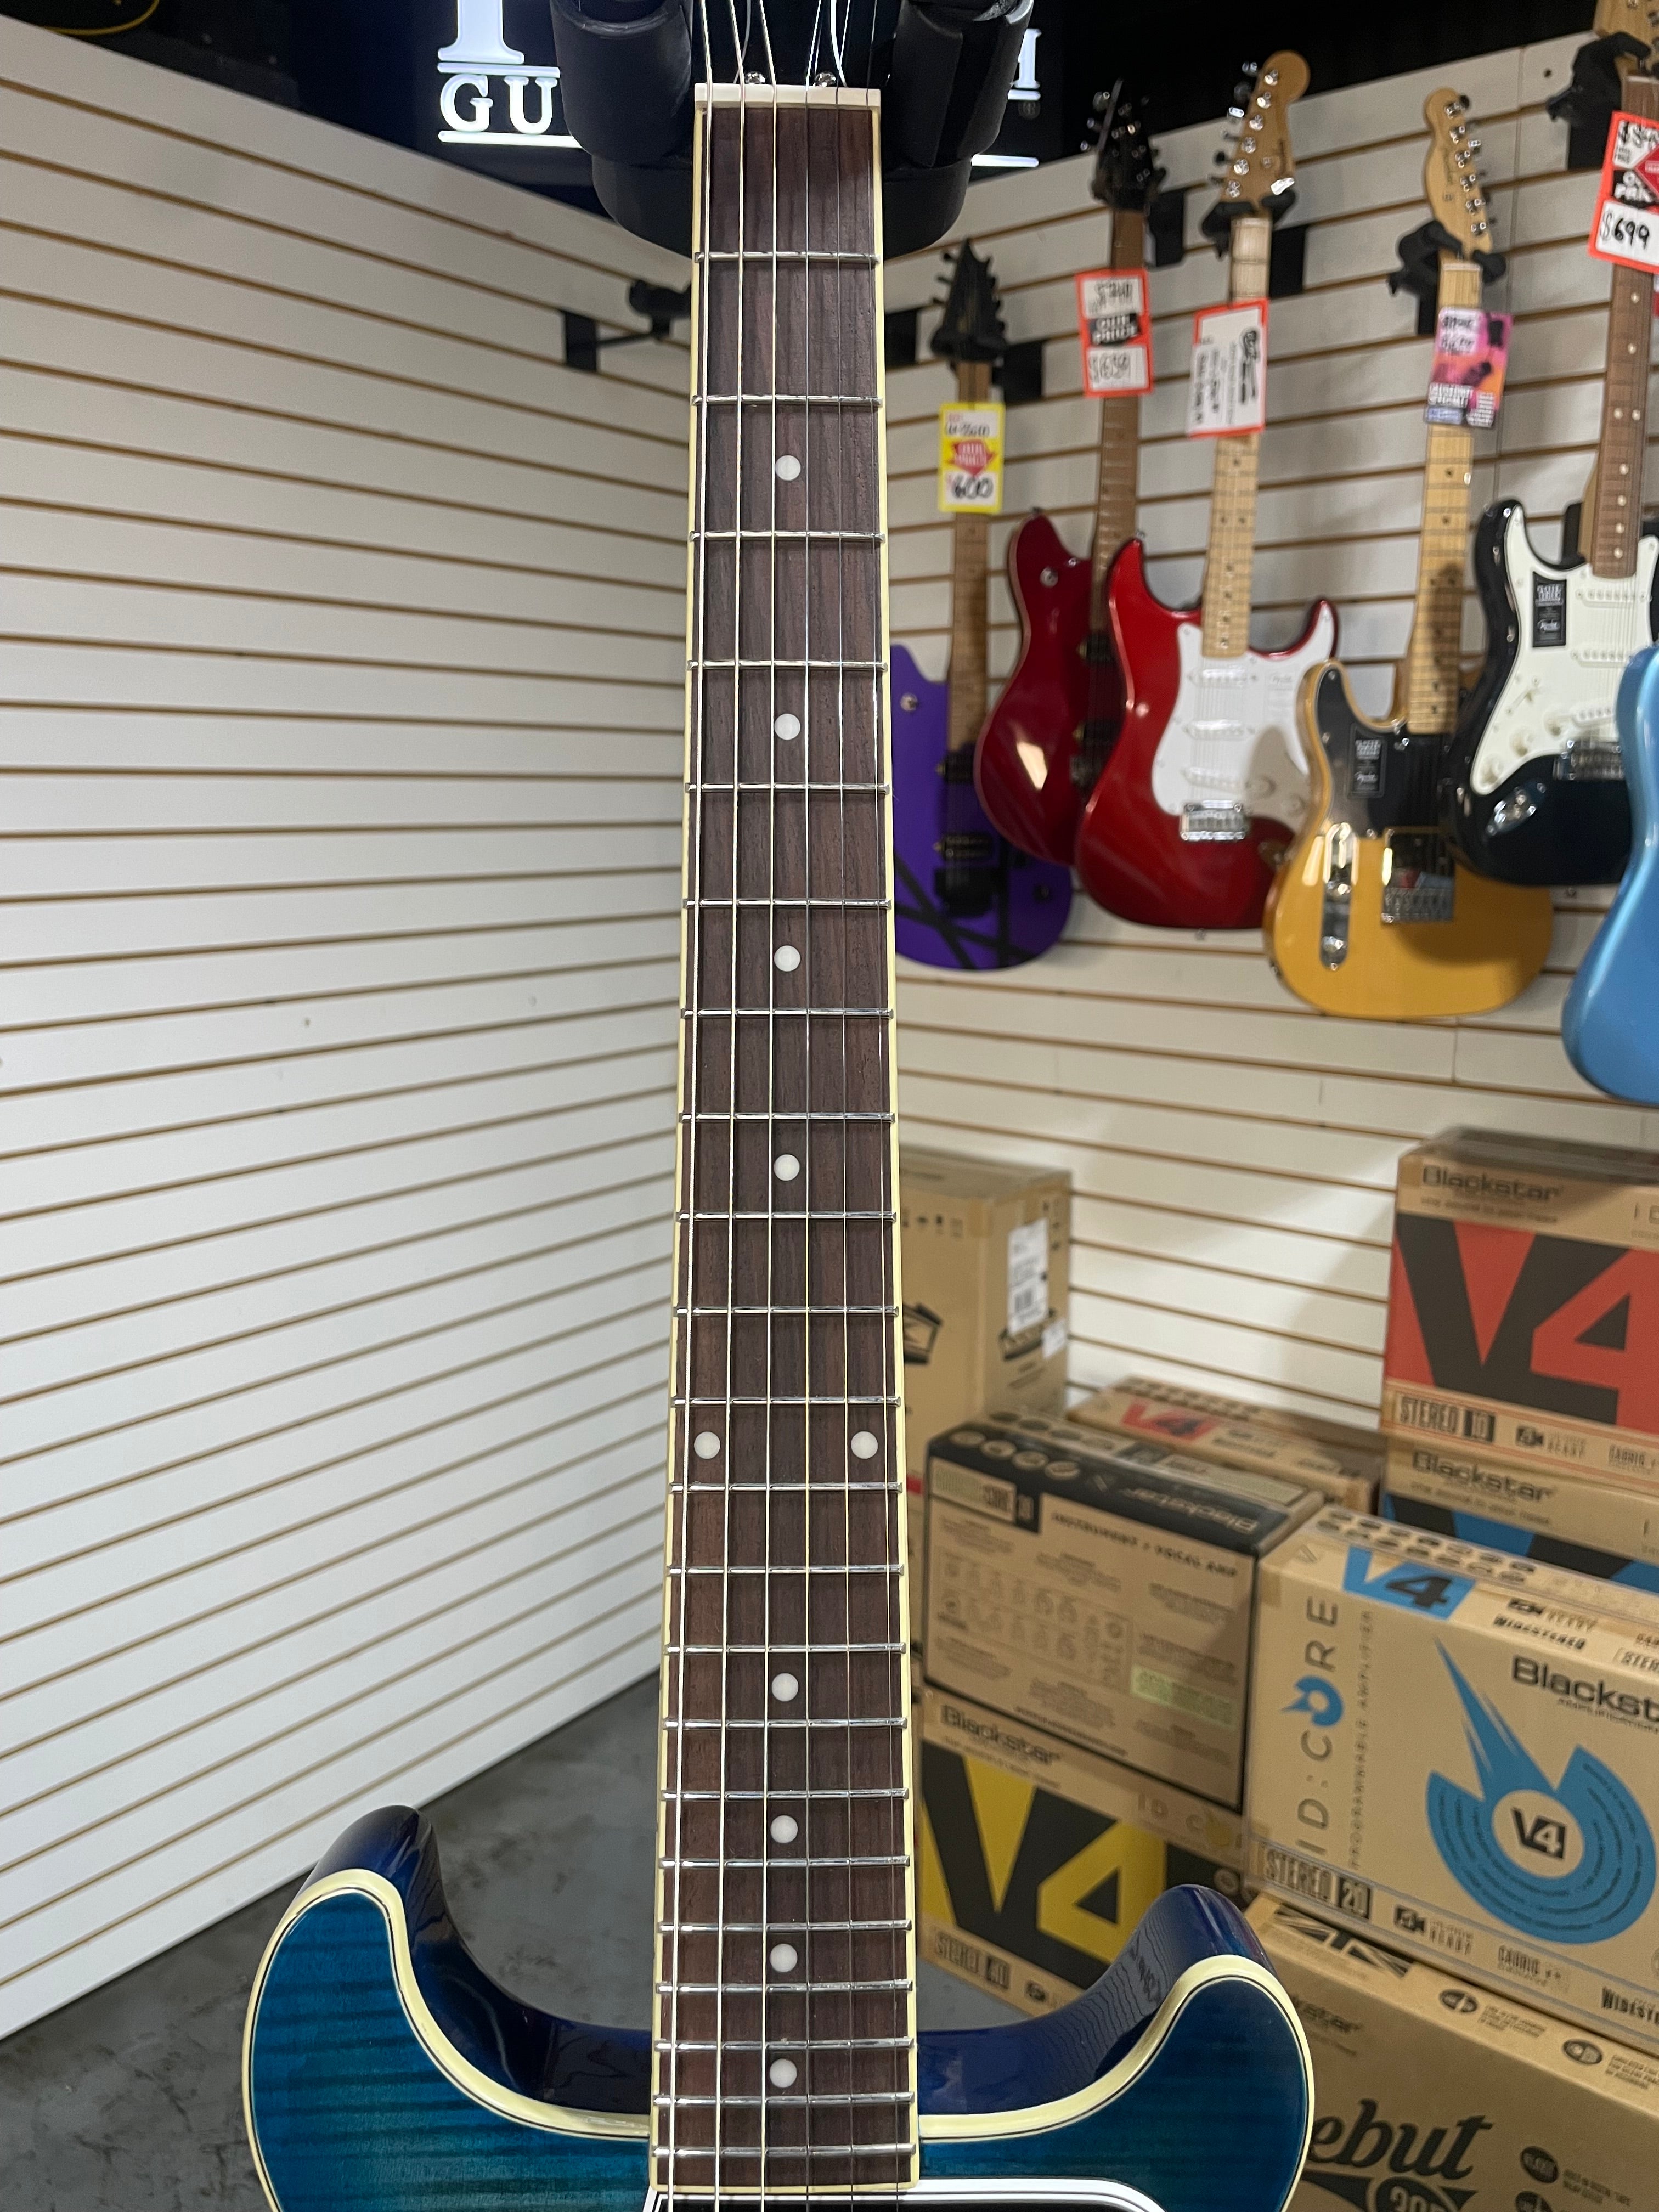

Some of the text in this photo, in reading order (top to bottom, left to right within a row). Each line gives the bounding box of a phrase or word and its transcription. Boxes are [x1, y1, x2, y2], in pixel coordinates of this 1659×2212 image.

[1412, 1448, 1556, 1502] Blackstar
[1342, 1546, 1476, 1621] V4
[1511, 1807, 1565, 1859] V4
[1308, 2098, 1493, 2180] ebut
